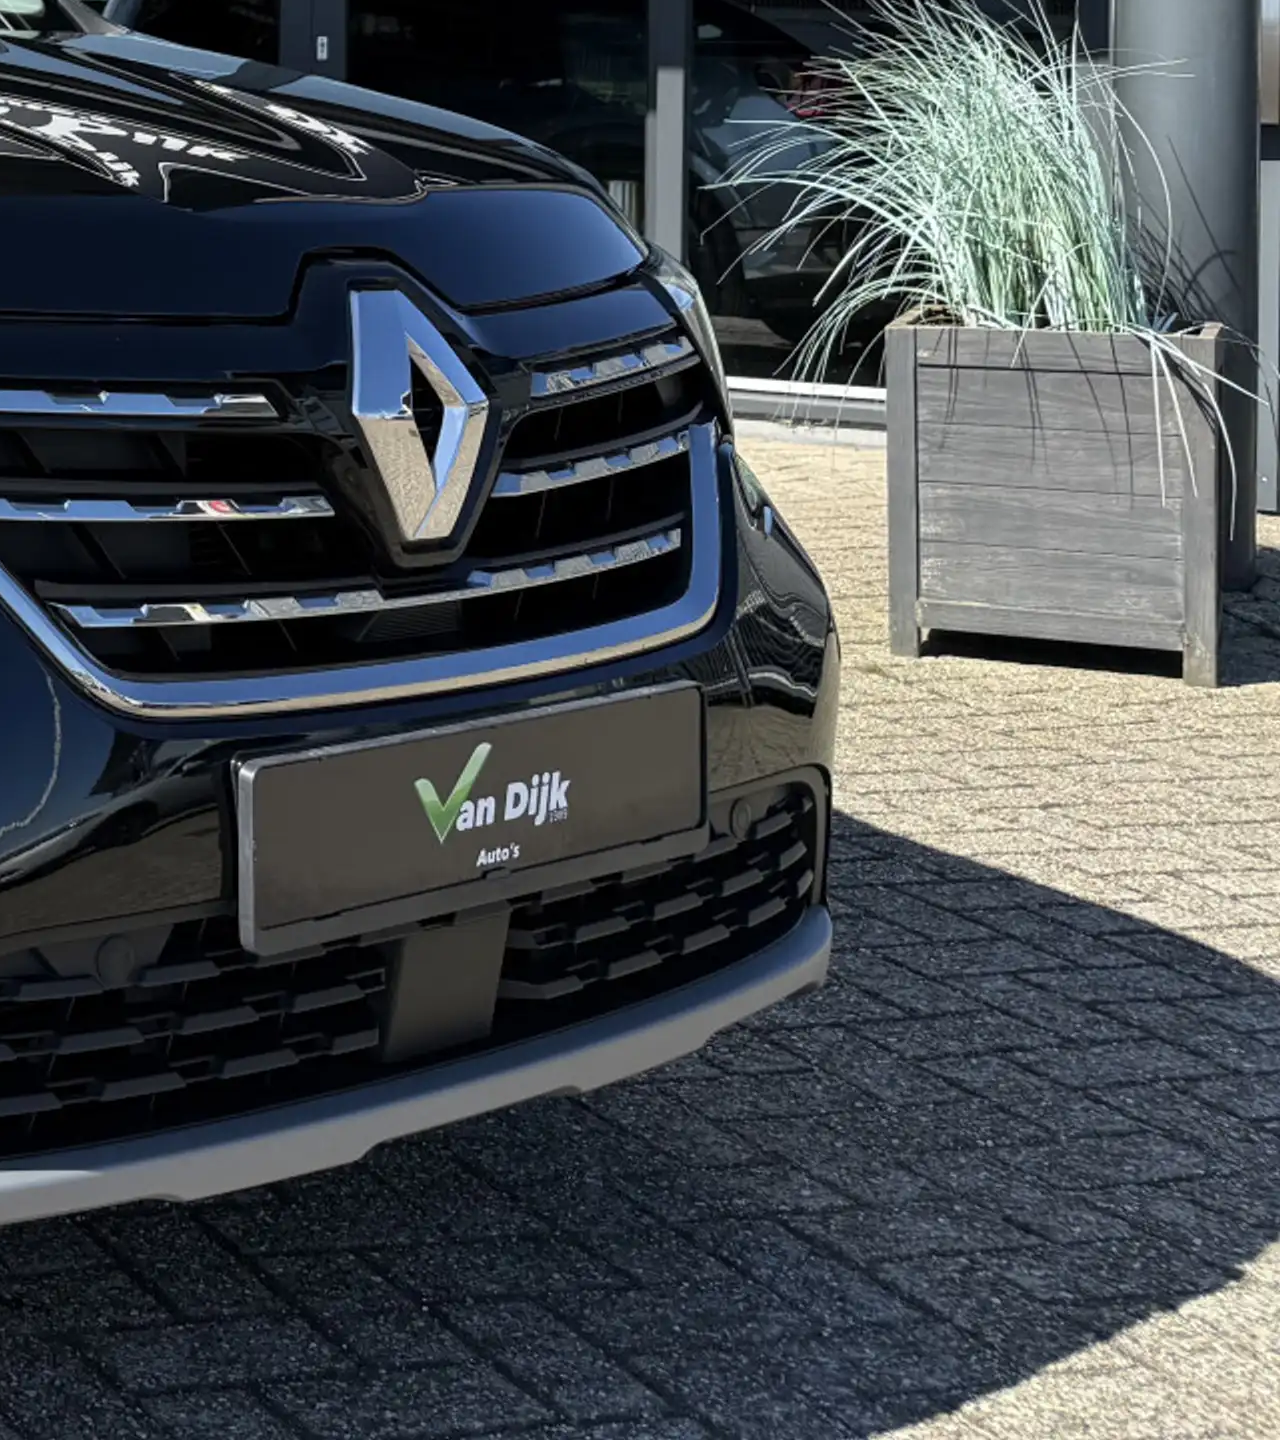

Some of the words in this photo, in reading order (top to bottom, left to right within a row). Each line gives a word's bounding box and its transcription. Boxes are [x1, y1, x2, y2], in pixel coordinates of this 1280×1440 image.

[414, 742, 496, 844] Van
[504, 770, 571, 826] Dijk
[476, 842, 520, 867] Auto's
